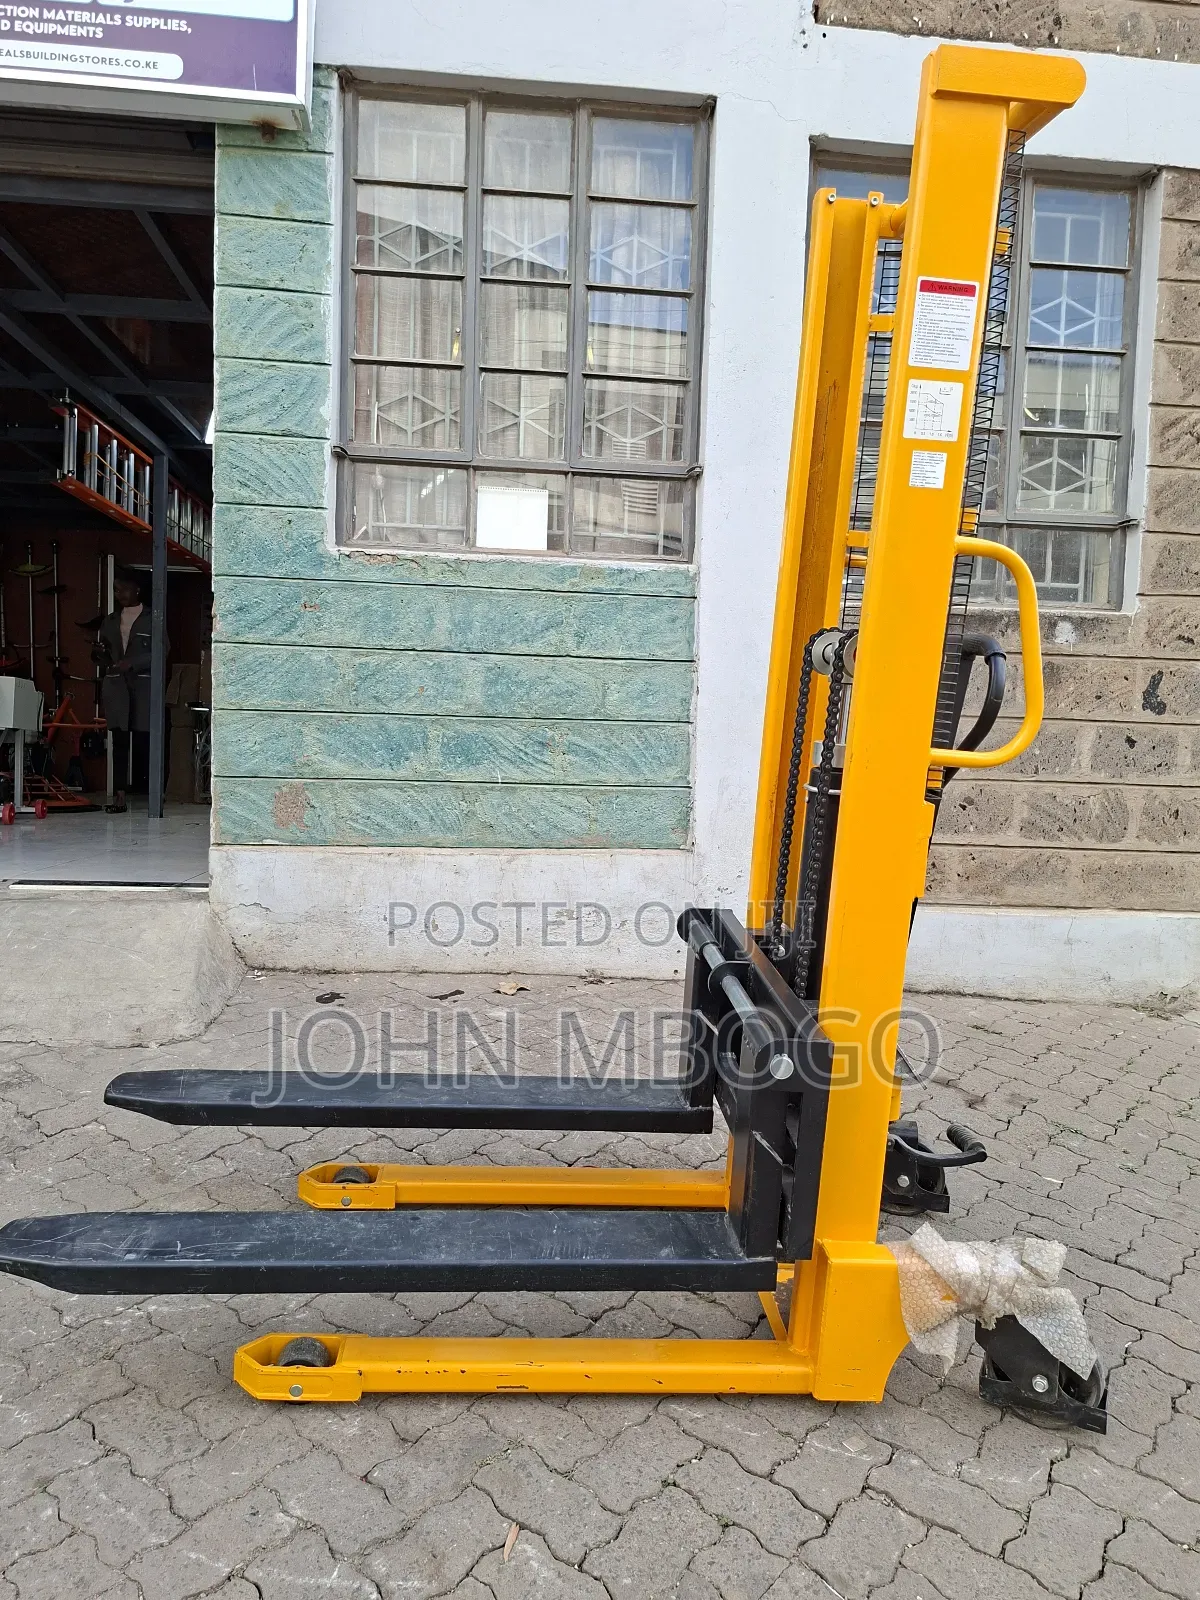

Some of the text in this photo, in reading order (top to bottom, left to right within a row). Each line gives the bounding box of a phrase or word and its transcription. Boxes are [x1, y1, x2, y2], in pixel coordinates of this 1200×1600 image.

[14, 20, 104, 39] EQUIPMENTS
[43, 8, 122, 26] MATERIALS
[125, 15, 192, 34] SUPPLIES,
[0, 48, 159, 70] EALSBUILDINGSTORES.CO.KE
[937, 284, 969, 293] WARNING
